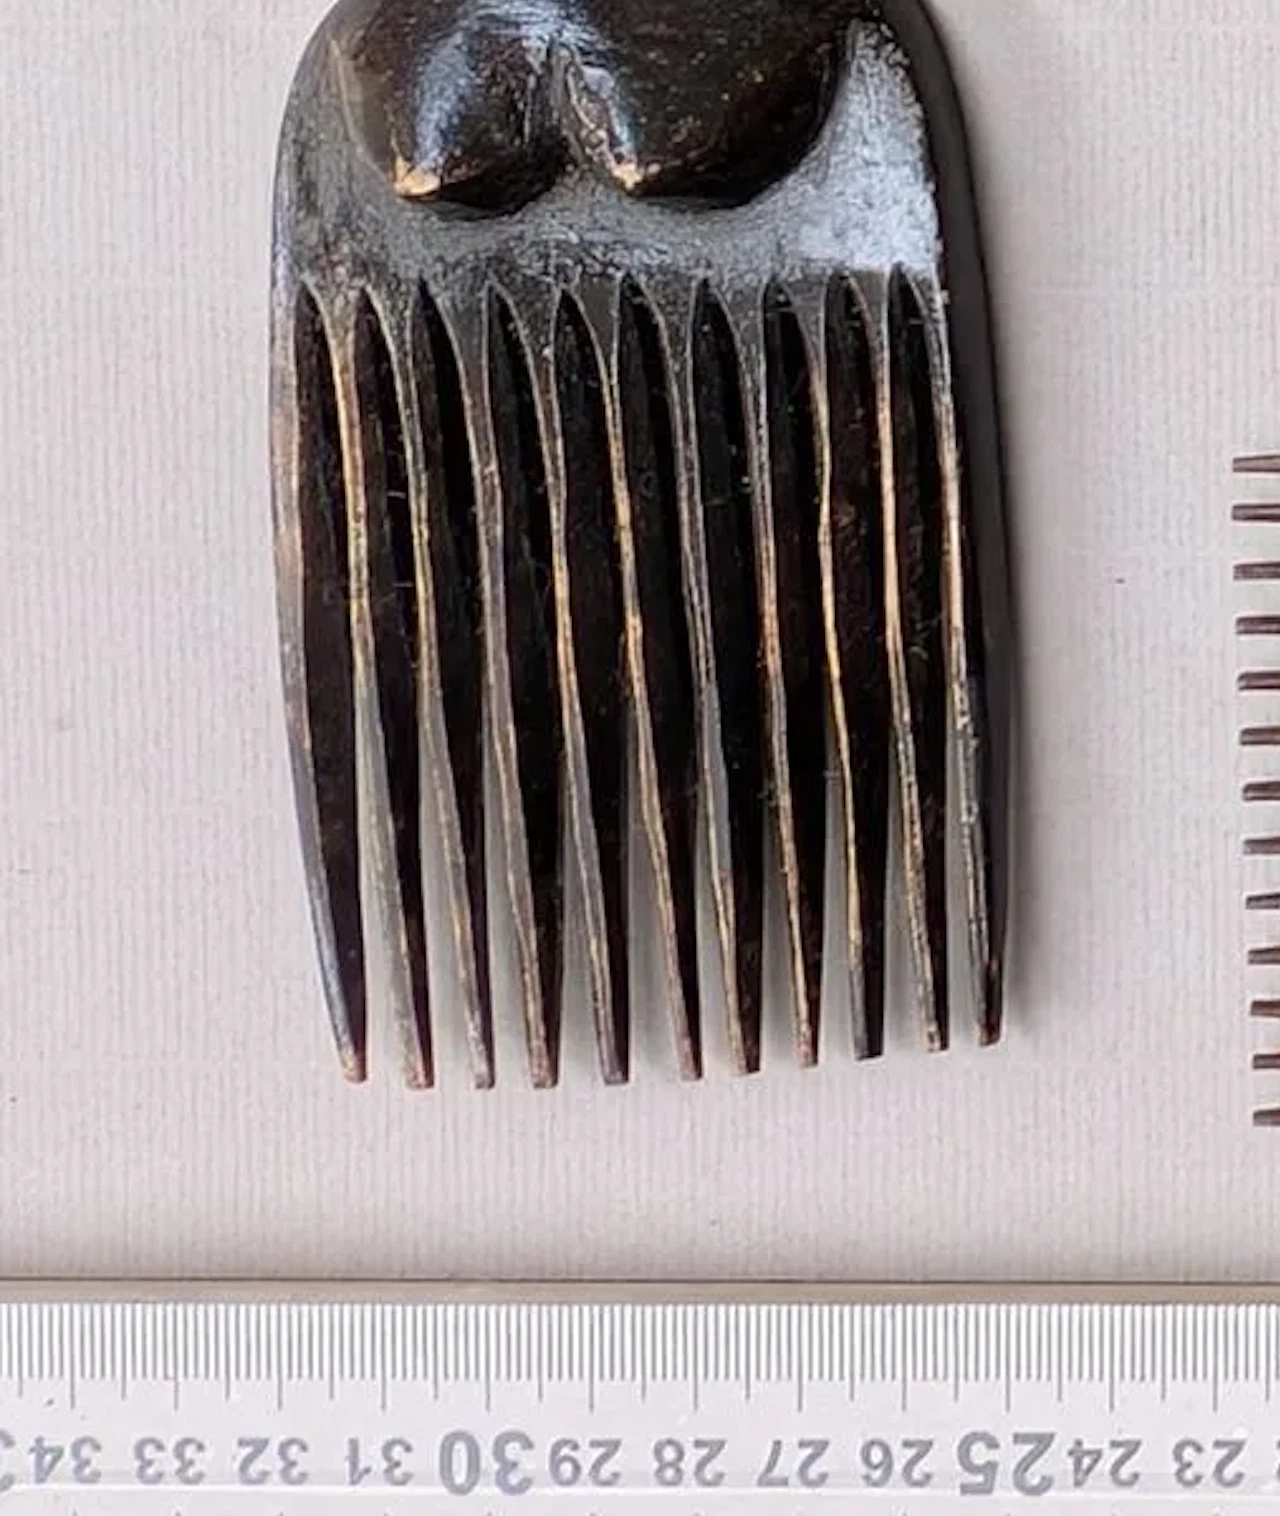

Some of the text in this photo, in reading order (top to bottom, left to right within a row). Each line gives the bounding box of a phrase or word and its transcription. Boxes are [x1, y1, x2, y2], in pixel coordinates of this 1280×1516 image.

[28, 1437, 104, 1485] 34
[131, 1437, 206, 1485] 33
[236, 1437, 312, 1485] 32
[344, 1436, 416, 1485] 31
[436, 1428, 537, 1494] 30
[546, 1438, 624, 1484] 29
[651, 1438, 728, 1484] 28
[756, 1438, 830, 1485] 27
[859, 1438, 935, 1486] 26
[955, 1430, 1056, 1496] 25
[1067, 1437, 1143, 1487] 24
[1172, 1438, 1246, 1487] 23
